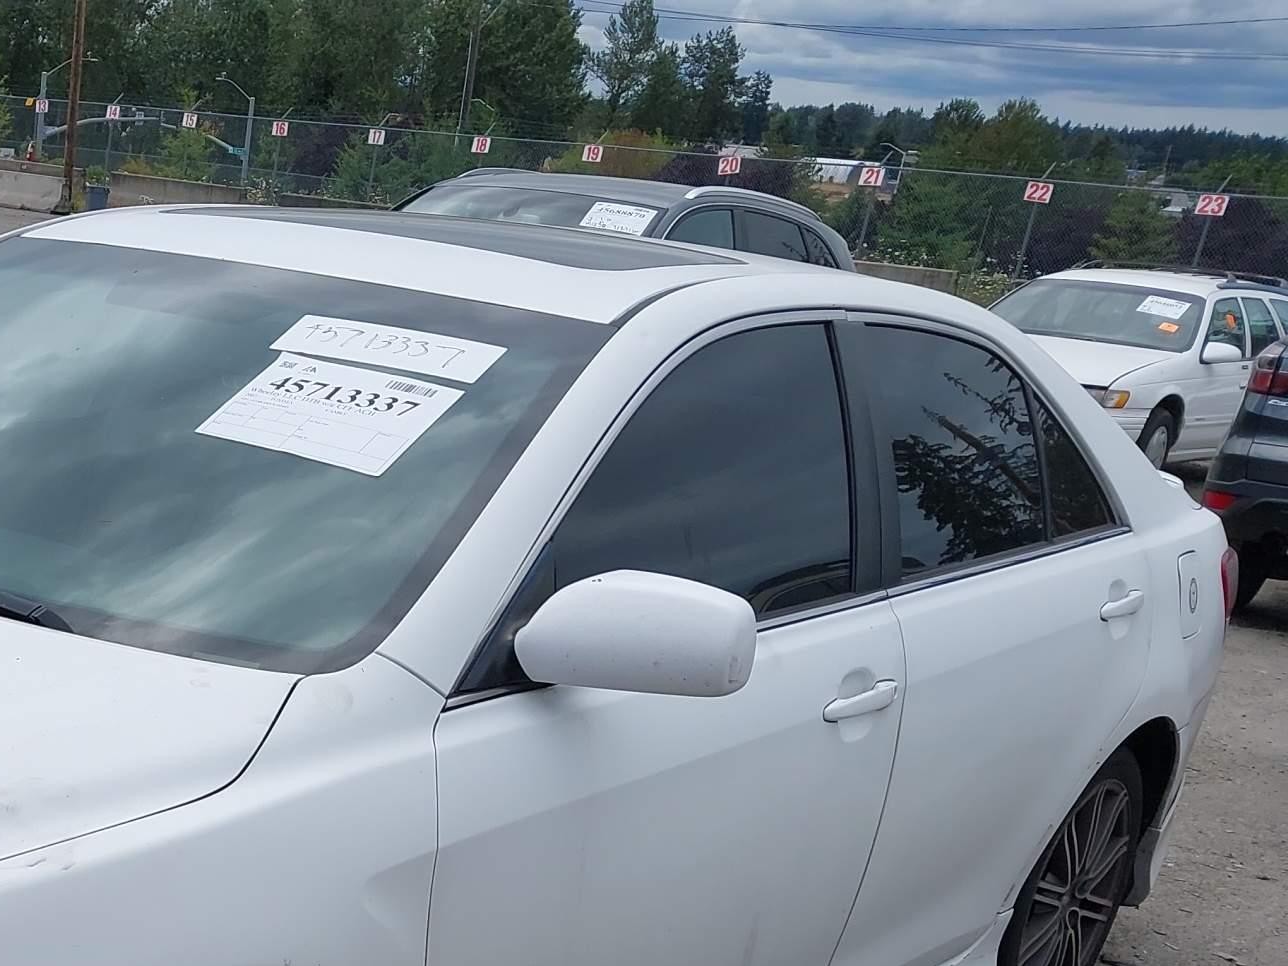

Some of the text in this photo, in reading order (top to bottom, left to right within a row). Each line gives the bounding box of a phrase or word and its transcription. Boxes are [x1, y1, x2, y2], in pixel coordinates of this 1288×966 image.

[37, 101, 47, 112] 13
[107, 106, 118, 118] 14
[185, 114, 196, 127] 15
[273, 121, 287, 136] 16
[369, 129, 383, 144] 17
[473, 137, 489, 153] 18
[585, 145, 601, 162] 19
[720, 157, 739, 174] 20
[862, 168, 881, 185] 21
[1026, 183, 1050, 202] 22
[1197, 195, 1227, 215] 23
[268, 375, 421, 417] 45713337
